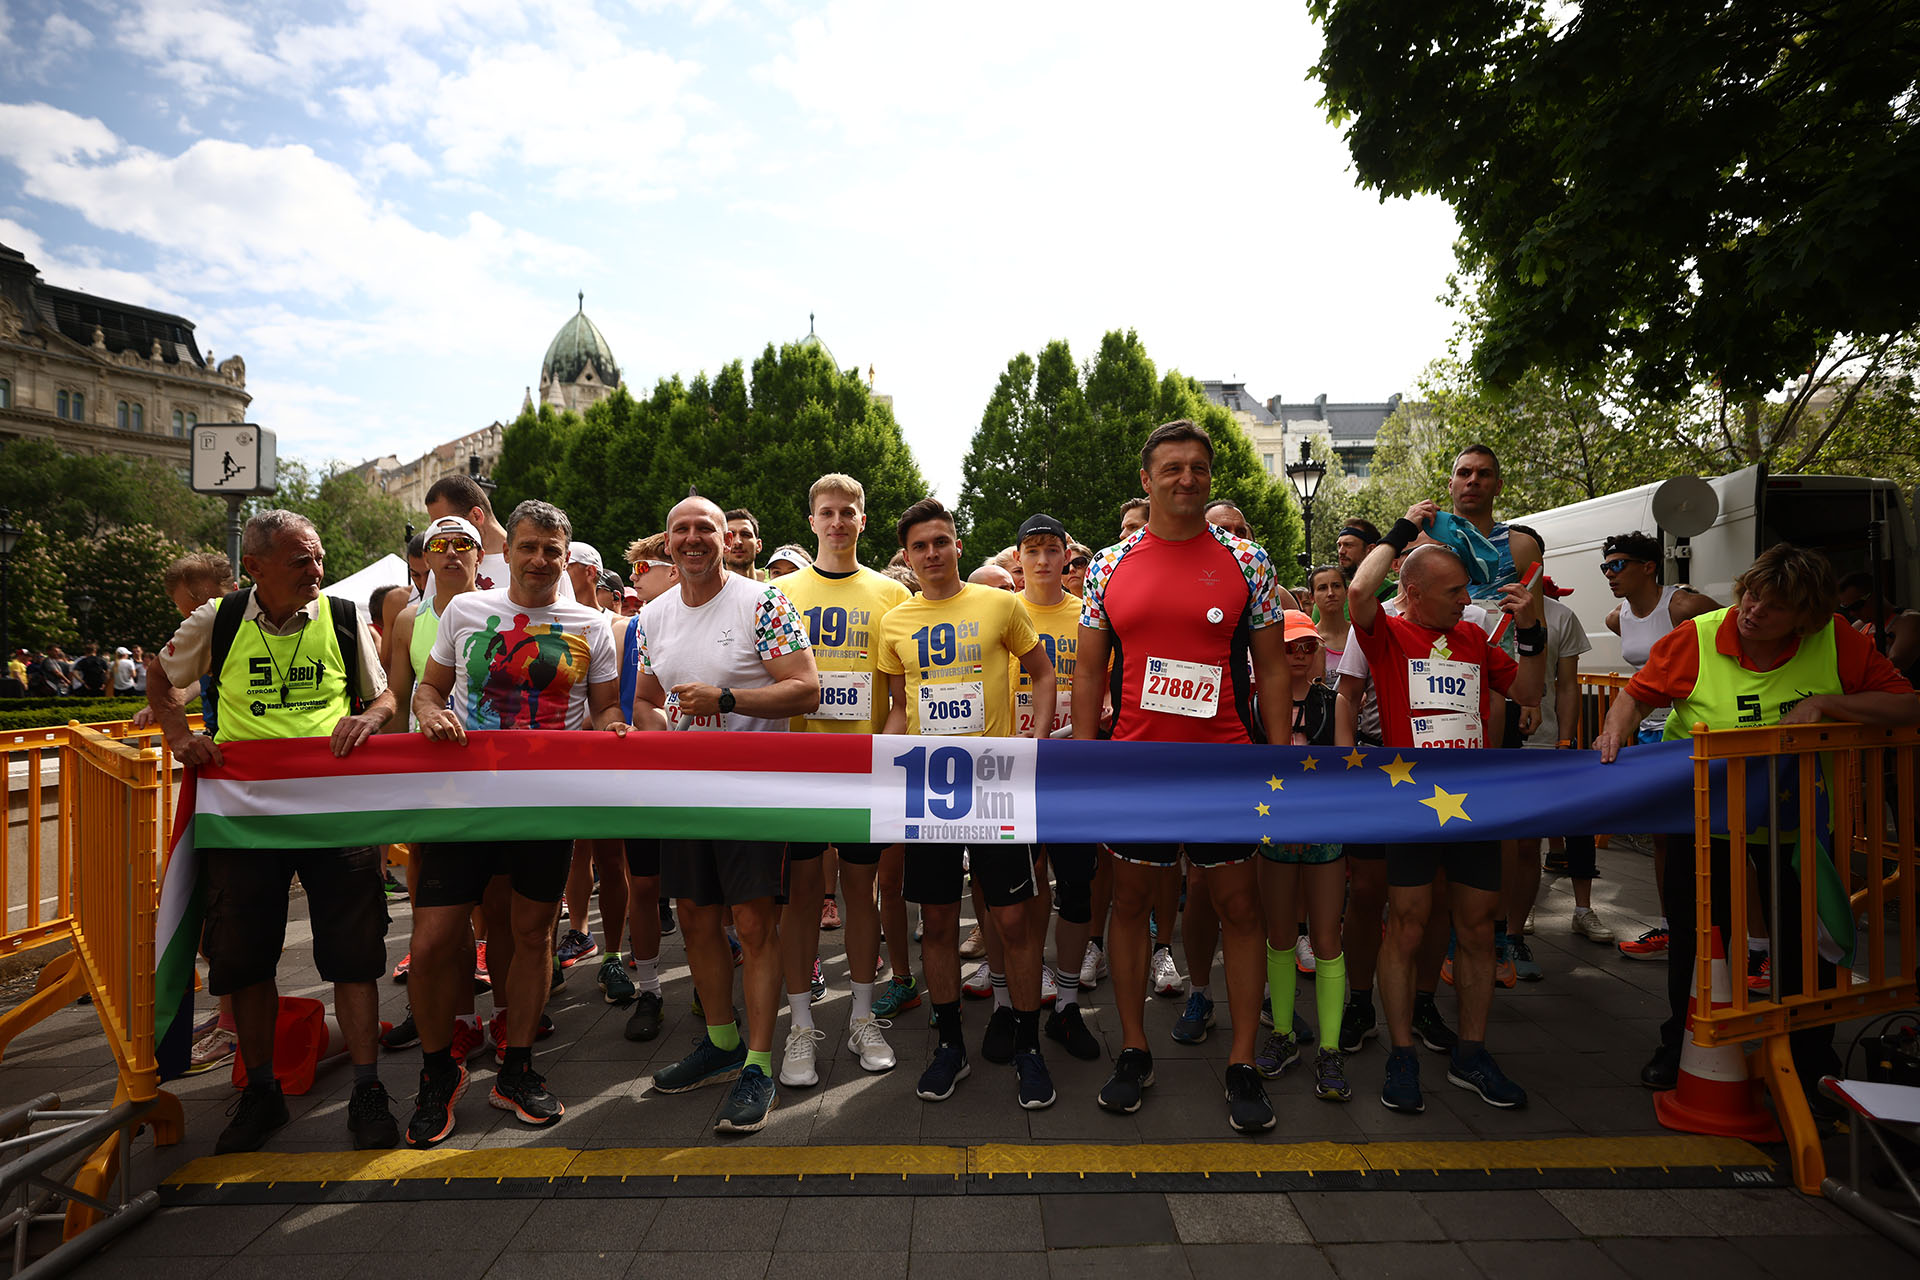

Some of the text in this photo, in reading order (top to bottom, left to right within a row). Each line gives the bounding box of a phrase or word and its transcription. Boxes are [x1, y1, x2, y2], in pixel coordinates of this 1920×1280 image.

[803, 606, 848, 647] 19
[848, 607, 871, 626] év
[847, 628, 870, 649] km
[957, 619, 979, 640] év
[911, 623, 957, 669] 19
[957, 642, 983, 663] km
[1057, 635, 1077, 653] év
[289, 666, 314, 681] BBU
[1149, 659, 1162, 673] 19
[1411, 660, 1424, 672] 19
[820, 687, 858, 705] 1858
[920, 686, 929, 699] 19
[1148, 675, 1215, 702] 2788/2
[1426, 675, 1466, 696] 1192
[1016, 693, 1028, 704] 19
[928, 699, 972, 720] 2063
[1413, 718, 1427, 731] 19
[976, 748, 1015, 781] év
[893, 746, 973, 820] 19
[975, 786, 1015, 819] km
[921, 823, 1000, 840] FUTÓVERSENY
